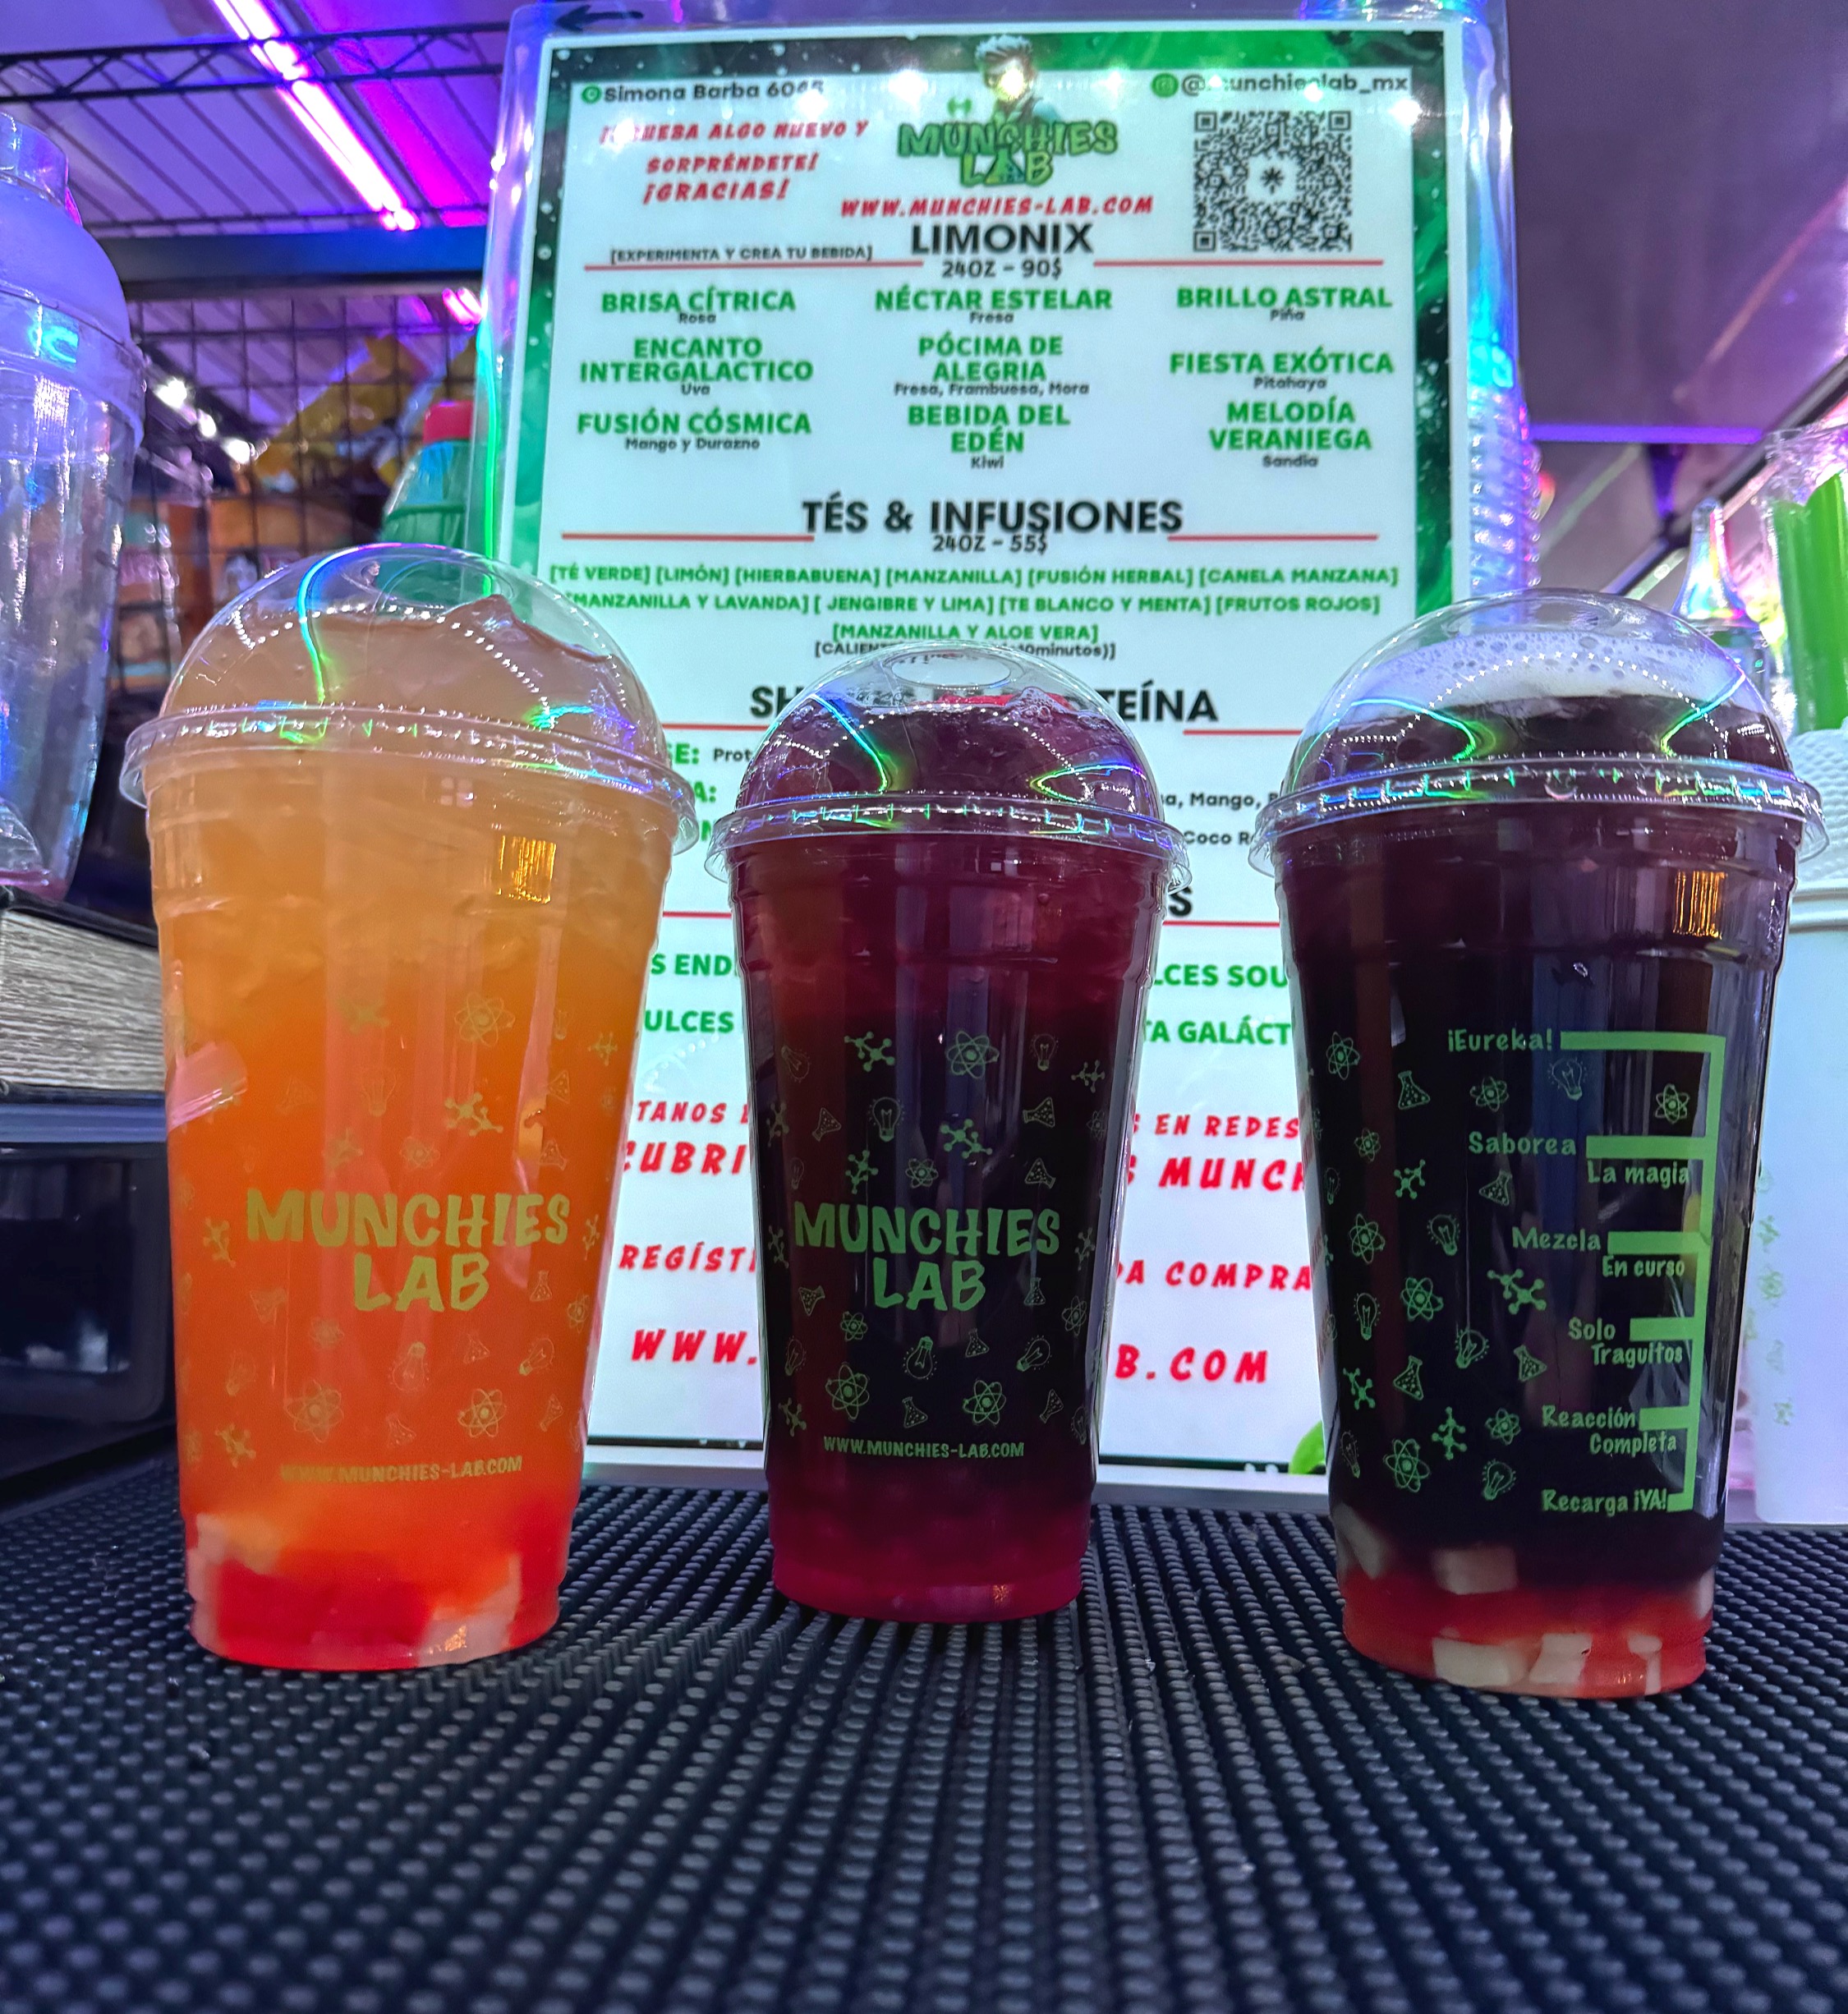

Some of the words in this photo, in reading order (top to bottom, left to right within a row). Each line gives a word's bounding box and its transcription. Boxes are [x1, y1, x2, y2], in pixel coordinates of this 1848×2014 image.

[604, 84, 685, 102] Simona
[694, 82, 759, 99] Barba
[708, 123, 765, 140] ALGO
[774, 122, 847, 140] NUEVO
[855, 120, 869, 137] Y
[897, 120, 1119, 157] MUNCHIES
[646, 152, 820, 174] SORPRÉNDETE!
[643, 179, 789, 204] ¡GRACIAS!
[840, 195, 1153, 218] WWW.MUNCHIES-LAB.COM
[911, 223, 1094, 255] LIMONIX
[611, 249, 720, 265] [EXPERIMENTA
[726, 249, 735, 260] Y
[740, 248, 781, 260] CREA
[788, 247, 807, 260] TU
[811, 246, 873, 262] BEBIDA]
[1022, 259, 1062, 279] 90$
[601, 292, 681, 313] BRISA
[687, 285, 797, 312] CÍTRICA
[875, 284, 982, 311] NÉCTAR
[991, 289, 1113, 310] ESTELAR
[1176, 287, 1277, 308] BRILLO
[1284, 287, 1392, 308] ASTRAL
[678, 313, 716, 324] Rosa
[969, 312, 1014, 324] Fresa
[1270, 309, 1306, 321] Piña
[633, 338, 763, 359] ENCANTO
[917, 332, 1023, 356] PÓCIMA
[1029, 336, 1064, 356] DE
[1170, 352, 1265, 374] FIESTA
[1274, 344, 1394, 374] EXÓTICA
[580, 361, 813, 383] INTERGALACTICO
[932, 361, 1046, 382] ALEGRIA
[681, 383, 710, 396] Uva
[894, 383, 944, 397] Fresa,
[949, 383, 1044, 397] Frambuesa,
[1049, 383, 1089, 394] Mora
[1253, 376, 1326, 392] Pitahaya
[908, 404, 1009, 426] BEBIDA
[1018, 404, 1071, 425] DEL
[1227, 394, 1356, 423] MELODÍA
[577, 407, 679, 435] FUSIÓN
[687, 406, 811, 435] CÓSMICA
[625, 438, 677, 453] Mango
[682, 439, 691, 453] y
[696, 438, 760, 450] Durazno
[950, 425, 1025, 453] EDÉN
[1209, 428, 1372, 450] VERANIEGA
[971, 455, 1004, 469] Kiwi
[802, 492, 868, 532] TÉS
[884, 501, 913, 533] &
[931, 501, 1184, 533] INFUSIONES
[1009, 533, 1048, 554] 55$
[549, 563, 579, 584] [TÉ
[585, 566, 650, 585] VERDE]
[656, 564, 729, 586] [LIMÓN]
[735, 567, 880, 587] [HIERBABUENA]
[886, 568, 1022, 588] [MANZANILLA]
[1028, 565, 1106, 588] [FUSIÓN
[1112, 568, 1193, 587] HERBAL]
[1200, 568, 1285, 587] [CANELA
[1291, 567, 1399, 587] MANZANA]
[697, 595, 709, 609] Y
[715, 595, 809, 614] LAVANDA]
[827, 597, 917, 611] JENGIBRE
[924, 597, 935, 611] Y
[941, 596, 994, 615] LIMA]
[1000, 596, 1029, 615] [TE
[1035, 597, 1114, 612] BLANCO
[1121, 597, 1132, 612] Y
[1138, 596, 1211, 615] MENTA]
[1216, 595, 1300, 615] [FRUTOS
[1305, 595, 1381, 615] ROJOS]
[832, 622, 960, 641] [MANZANILLA
[967, 624, 979, 639] Y
[985, 625, 1033, 640] ALOE
[1040, 624, 1098, 644] VERA]
[1190, 792, 1262, 811] Mango,
[1184, 830, 1231, 844] Coco
[1448, 1028, 1552, 1052] ¡Eureka!
[1155, 1114, 1190, 1135] EN
[1204, 1115, 1299, 1138] REDES
[1469, 1131, 1577, 1156] Saborea
[1588, 1161, 1616, 1184] La
[1625, 1162, 1690, 1189] magia
[247, 1189, 571, 1248] MUNCHIES
[793, 1202, 1060, 1257] MUNCHIES
[1512, 1226, 1601, 1251] Mezcla
[1165, 1261, 1311, 1291] COMPRA
[1602, 1255, 1629, 1277] En
[1634, 1258, 1685, 1277] curso
[354, 1253, 490, 1312] LAB
[873, 1258, 986, 1312] LAB
[1568, 1317, 1616, 1340] Solo
[1592, 1342, 1682, 1369] Traguitos
[1542, 1404, 1636, 1428] Reacción
[824, 1436, 1024, 1458] WWW.MUNCHIES-LAB.COM
[1589, 1431, 1677, 1458] Completa
[1542, 1488, 1629, 1517] Recarga
[1634, 1488, 1668, 1510] ¡YA!
